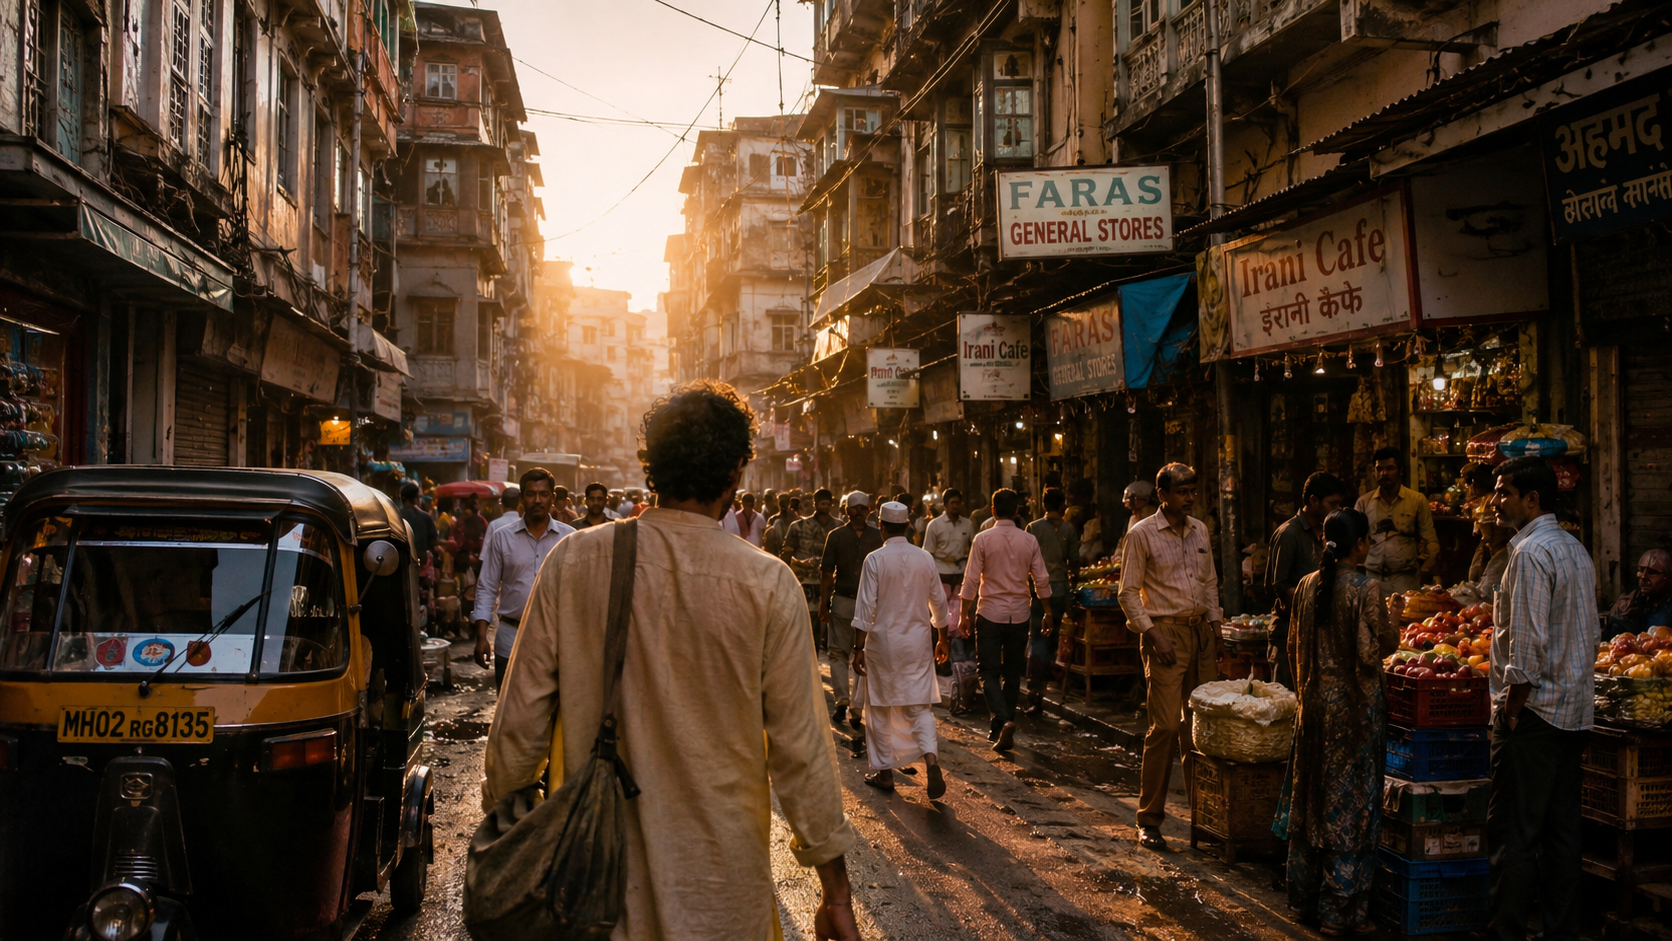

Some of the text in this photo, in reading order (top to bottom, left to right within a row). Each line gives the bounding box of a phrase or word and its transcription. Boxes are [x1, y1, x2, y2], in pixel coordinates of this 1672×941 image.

[1554, 92, 1666, 174] अहमद
[1008, 174, 1163, 210] FARAS
[1010, 216, 1164, 246] GENERAL STORES
[1239, 218, 1386, 298] Irani Cafe
[963, 340, 994, 359] Irani
[1050, 309, 1114, 356] FARAS
[62, 710, 209, 738] MH02 RG8135
